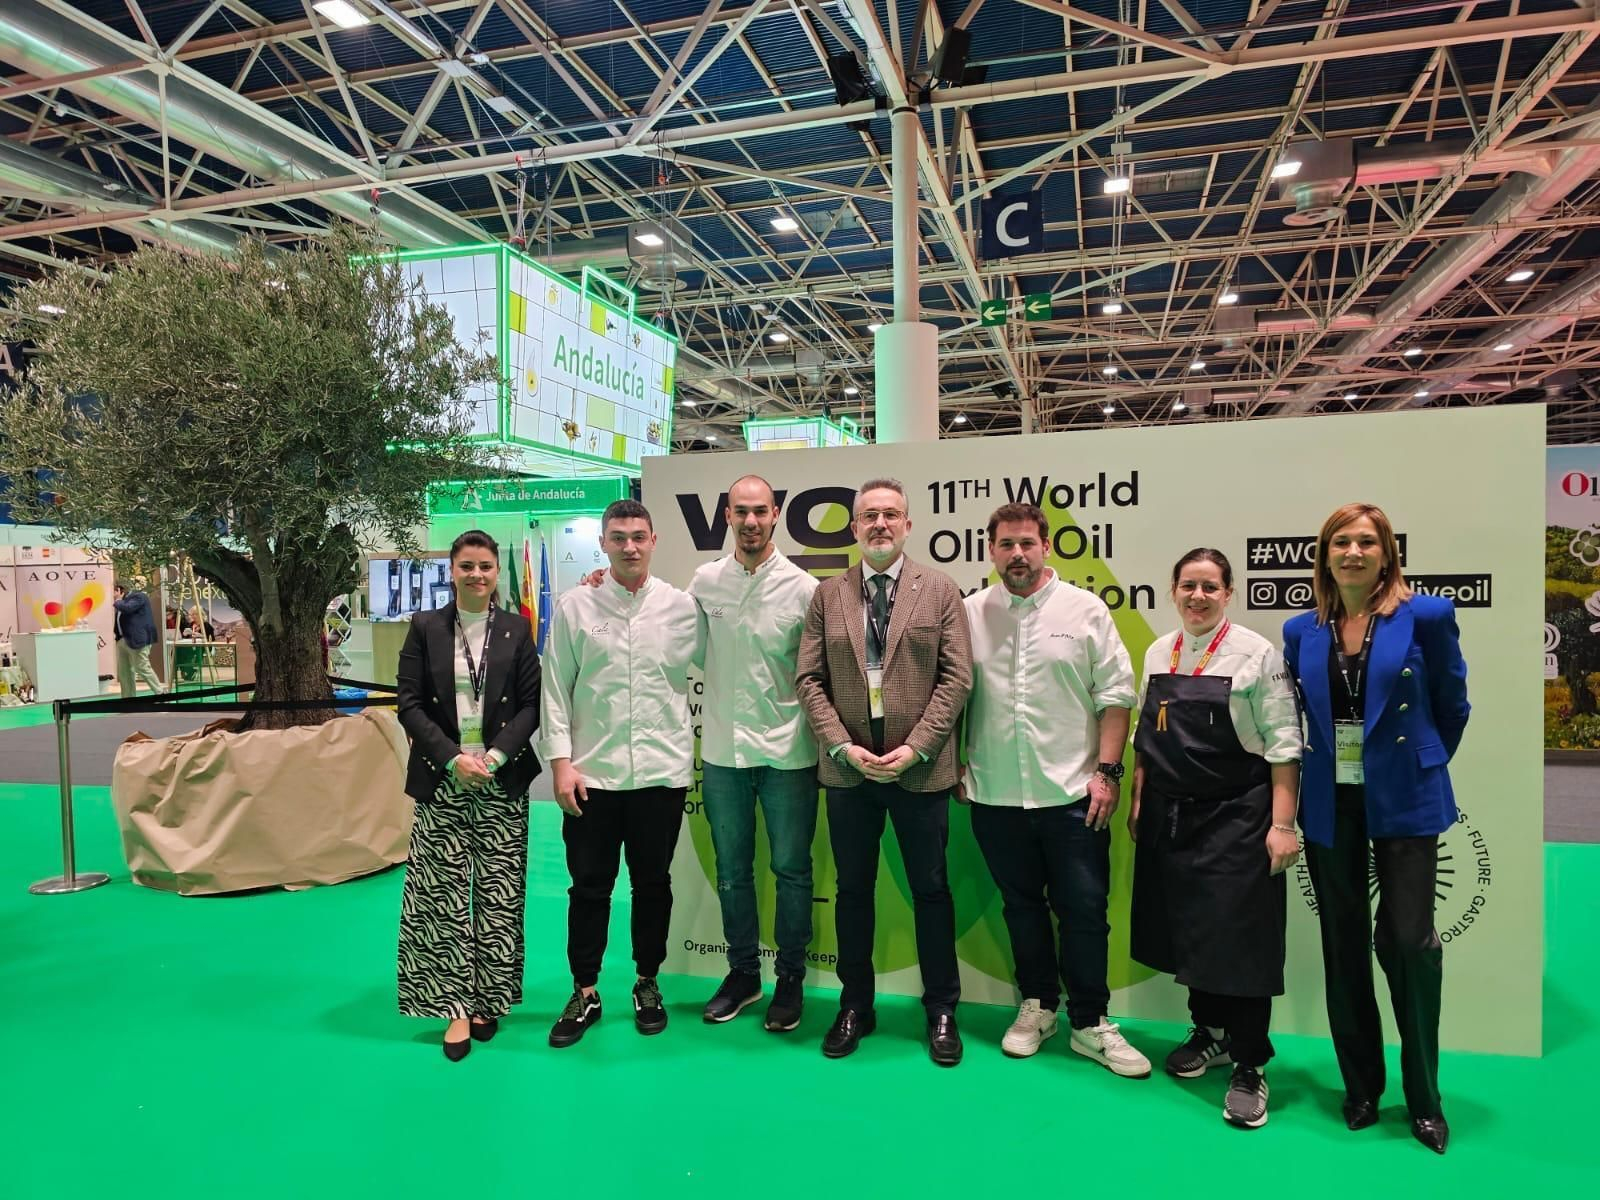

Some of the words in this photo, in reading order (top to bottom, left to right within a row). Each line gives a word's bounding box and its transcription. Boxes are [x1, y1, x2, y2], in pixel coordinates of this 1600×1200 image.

[996, 202, 1030, 247] C
[553, 334, 644, 401] Andalucía
[486, 491, 516, 501] Junta
[518, 489, 532, 500] de
[533, 487, 586, 500] Andalucía
[1003, 471, 1139, 509] World
[929, 529, 985, 564] Oli
[1053, 524, 1113, 560] Oil
[28, 571, 97, 582] AOVE
[1467, 831, 1491, 886] FUTURE
